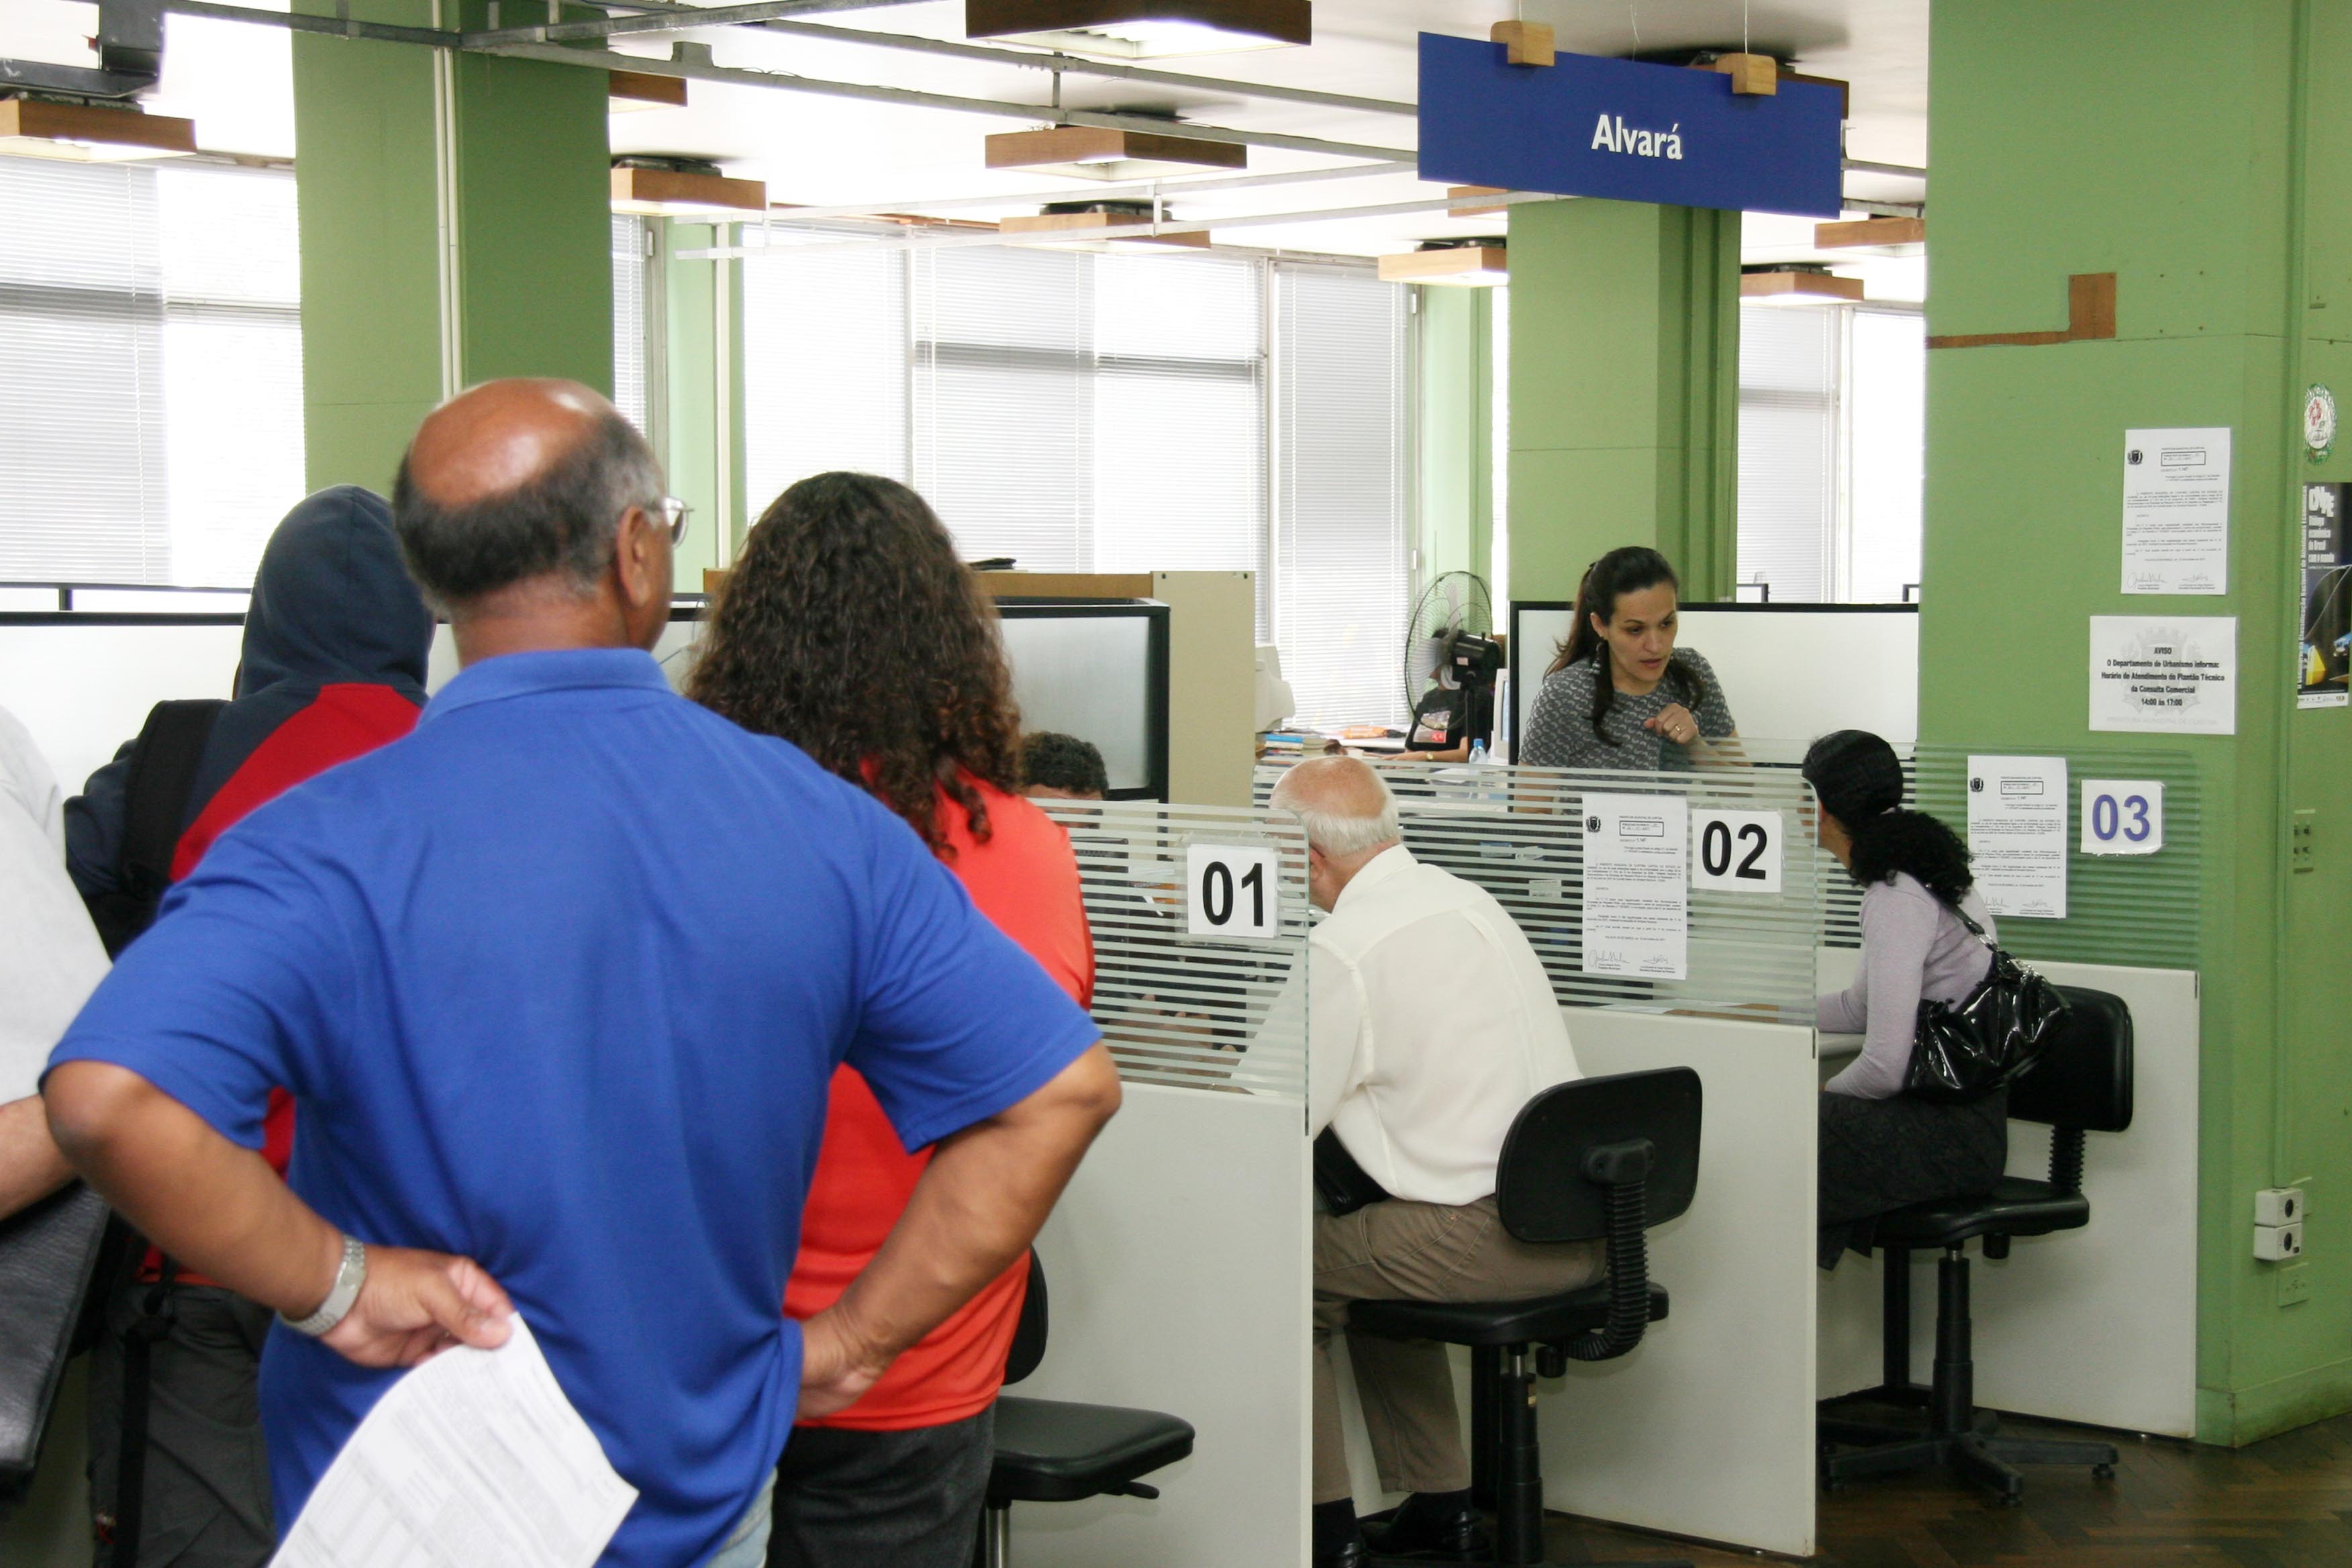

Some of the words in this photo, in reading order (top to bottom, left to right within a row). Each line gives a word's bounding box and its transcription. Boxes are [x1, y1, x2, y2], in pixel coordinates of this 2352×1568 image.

[1591, 114, 1683, 160] Alvará
[2113, 660, 2153, 668] Departamento
[2092, 794, 2150, 842] 03
[1702, 820, 1767, 880] 02
[1202, 861, 1264, 926] 01
